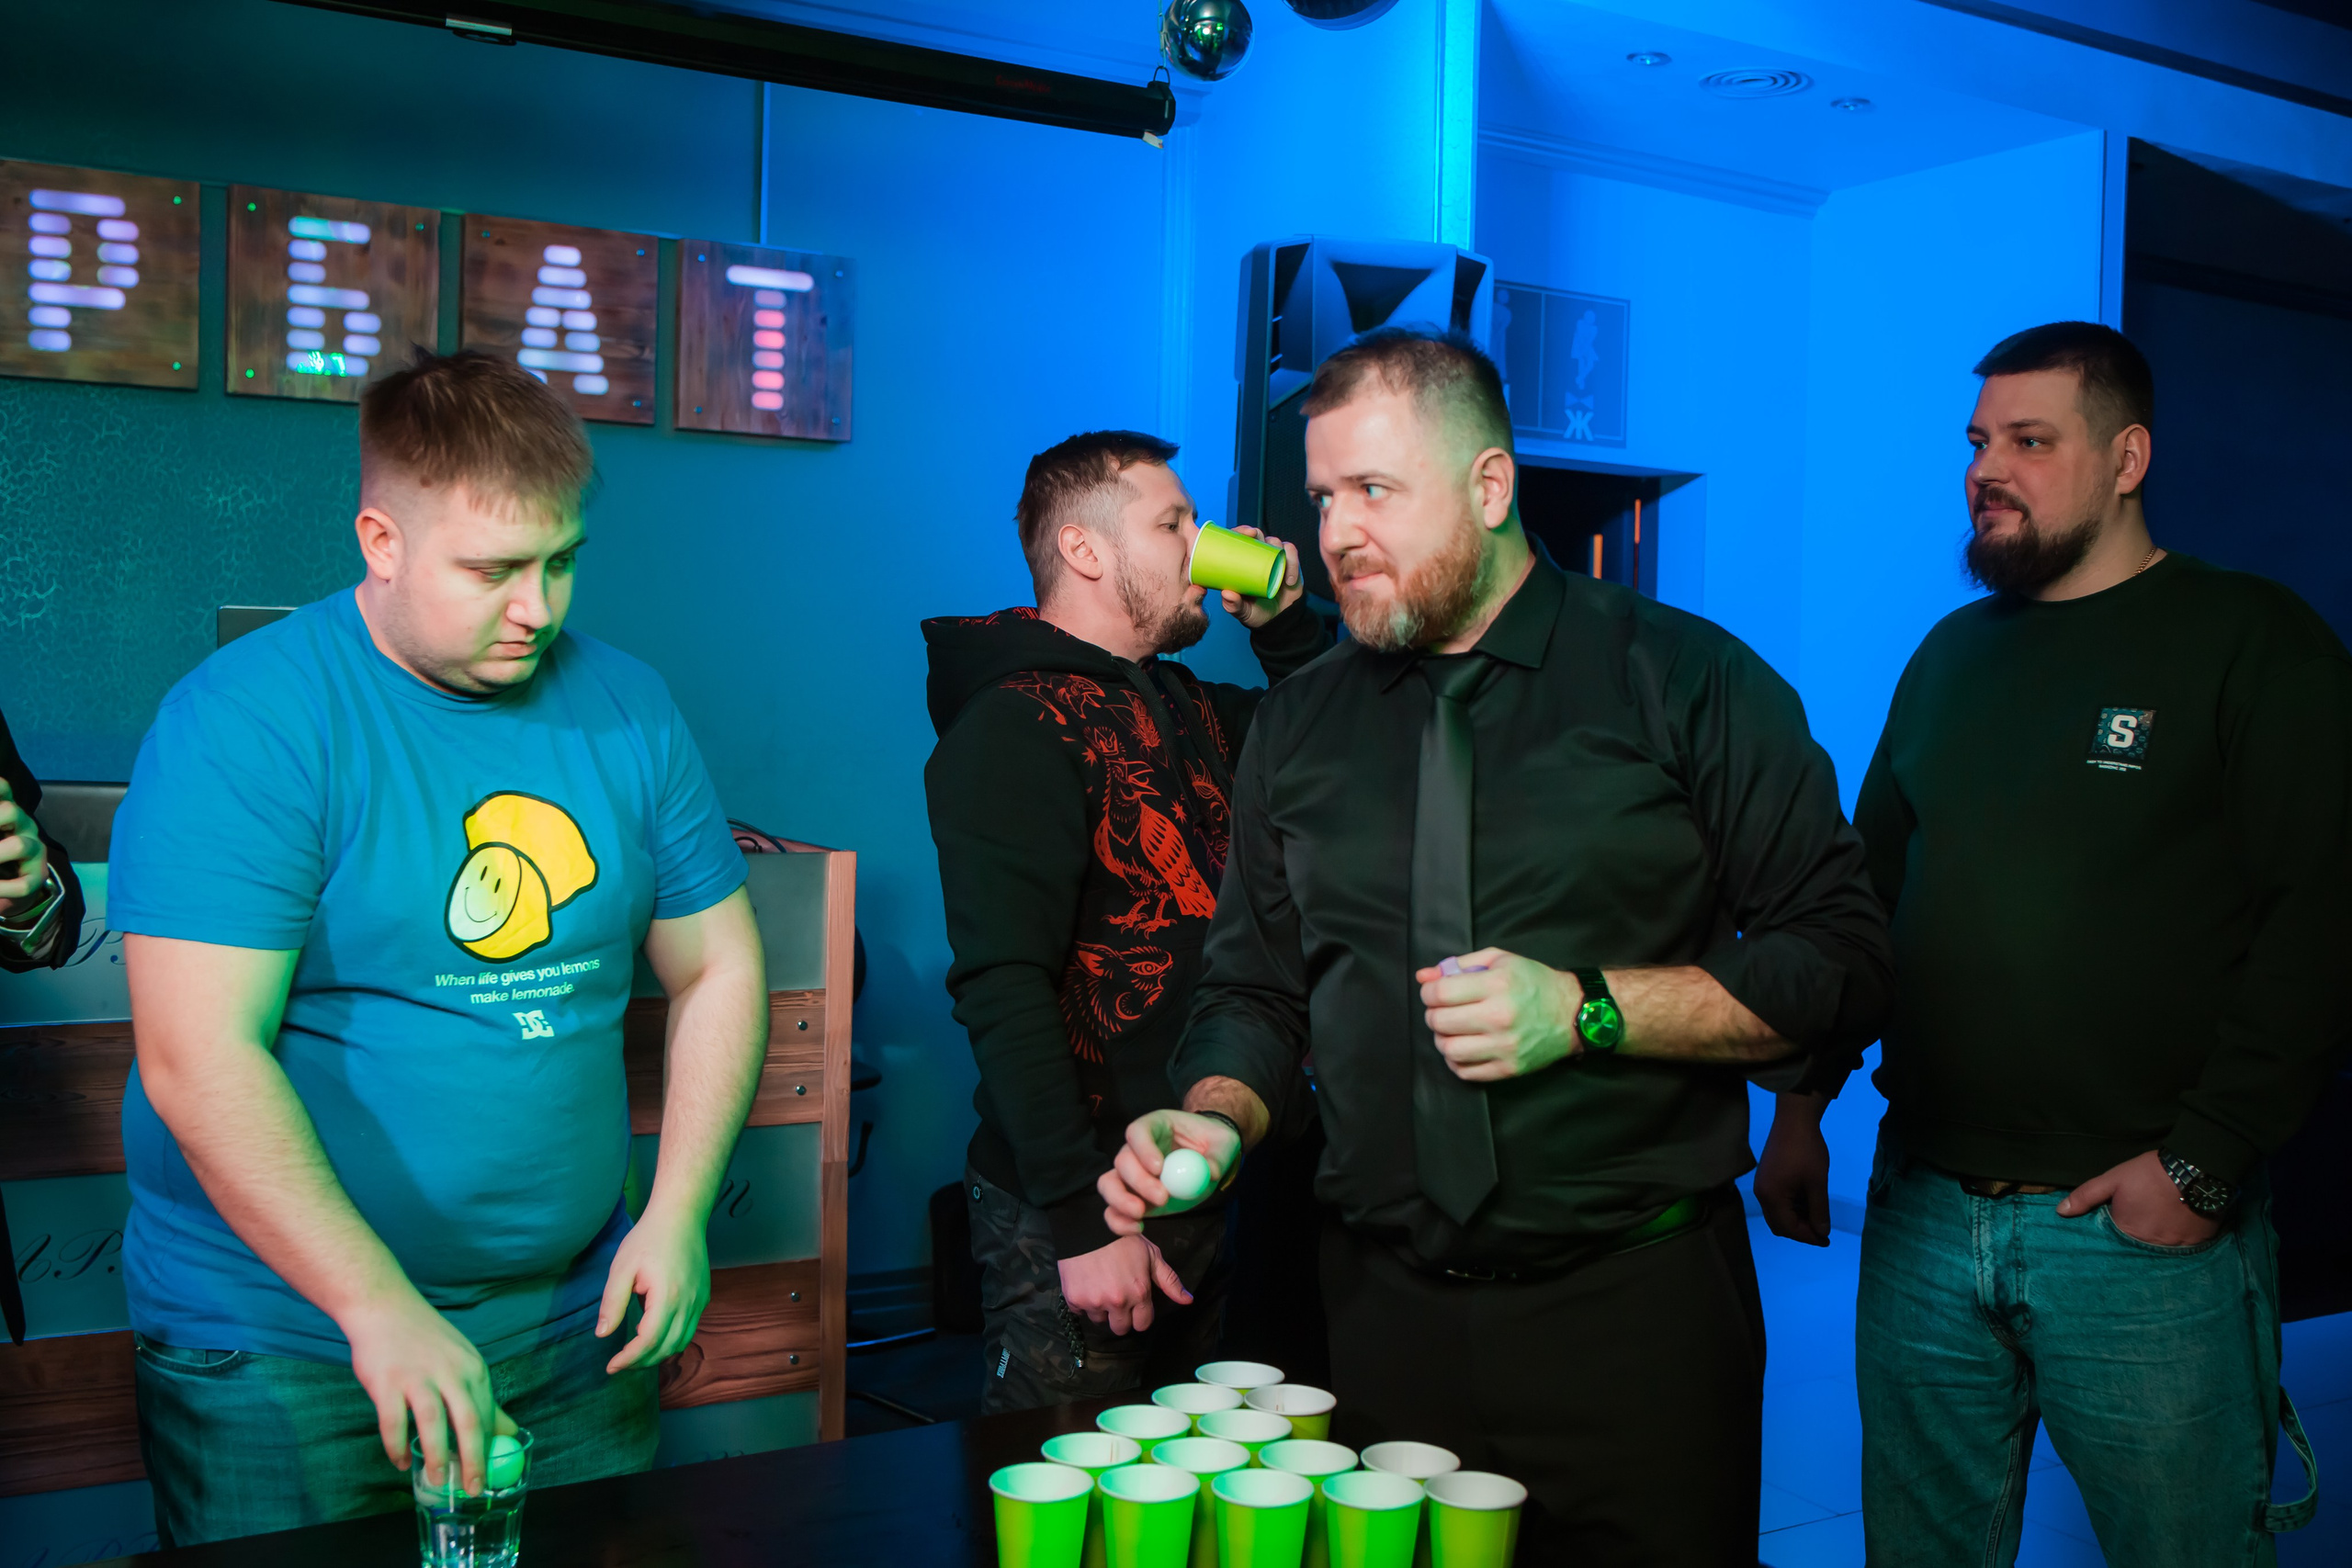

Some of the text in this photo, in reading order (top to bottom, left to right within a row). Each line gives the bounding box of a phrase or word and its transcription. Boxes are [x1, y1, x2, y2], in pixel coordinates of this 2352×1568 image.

[1563, 408, 1595, 442] Ж
[2107, 714, 2138, 748] S
[435, 959, 600, 987] When life gives you lemons
[469, 988, 509, 1005] make
